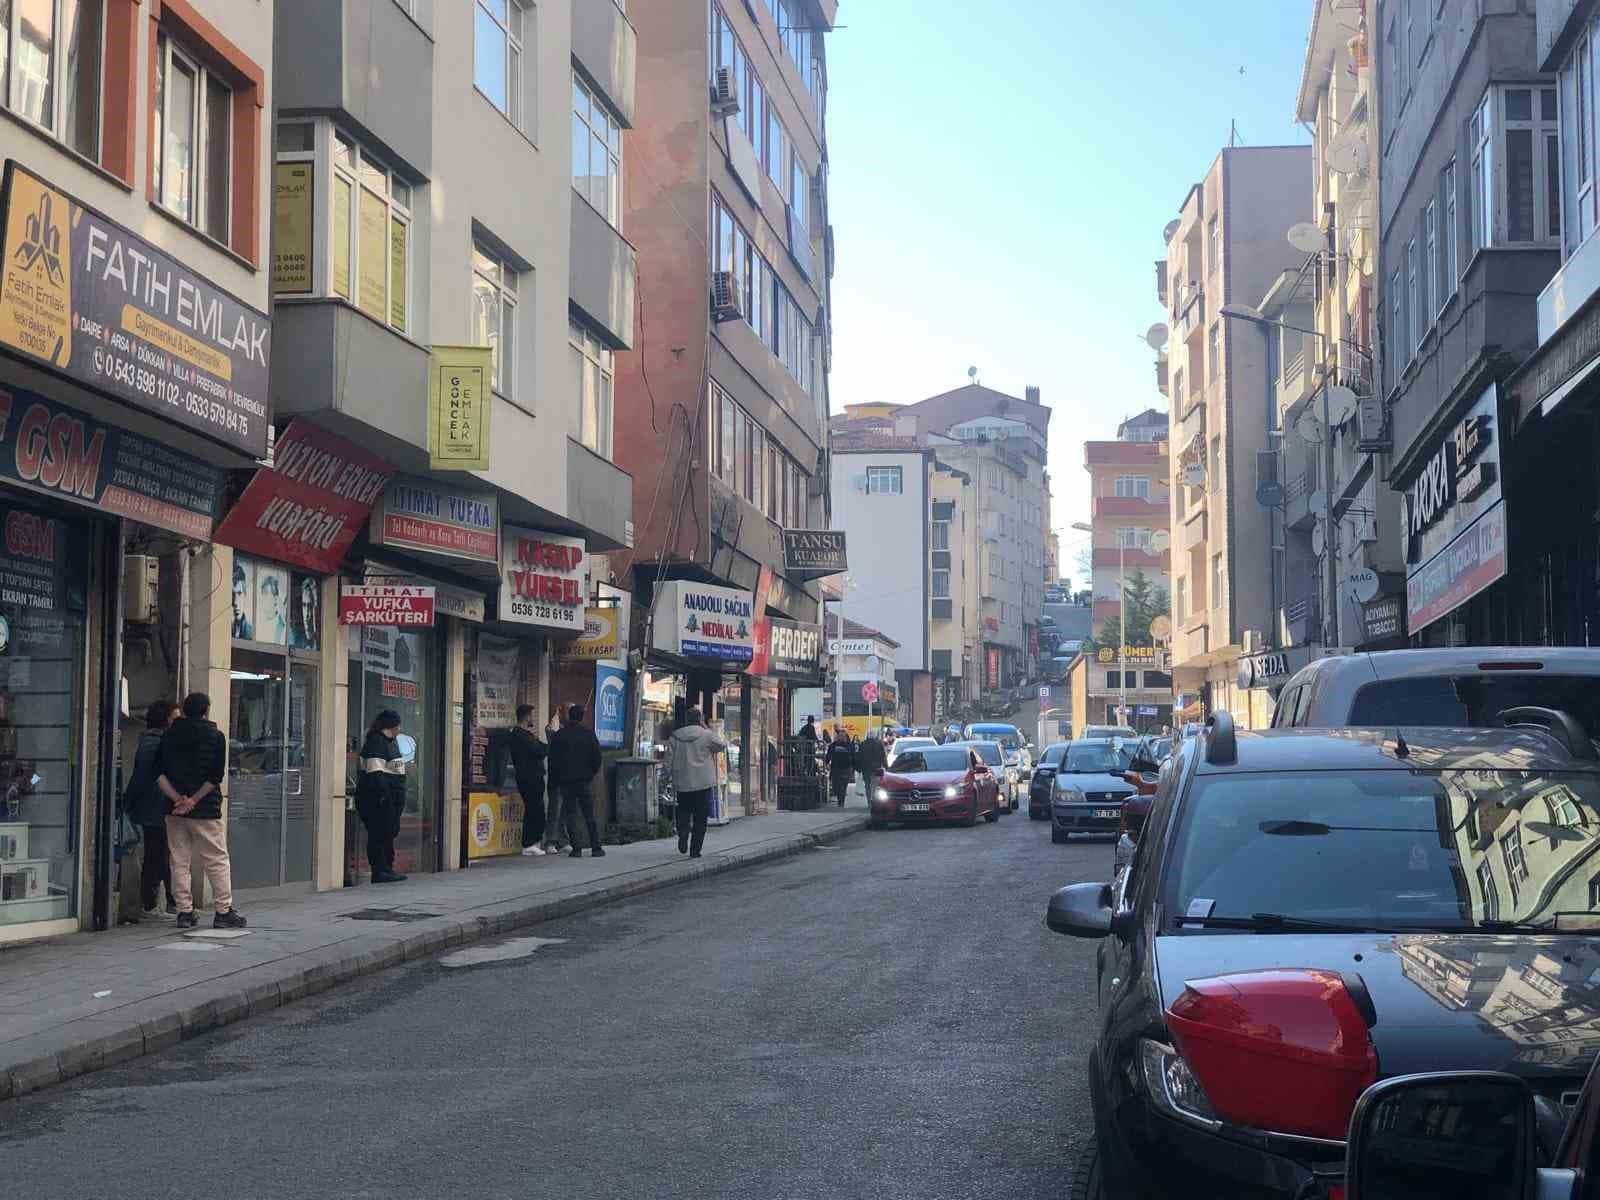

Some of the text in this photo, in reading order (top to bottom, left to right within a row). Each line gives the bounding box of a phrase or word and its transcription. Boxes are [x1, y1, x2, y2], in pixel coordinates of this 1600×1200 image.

[177, 278, 267, 368] EMLAK
[110, 332, 131, 353] ARSA
[185, 391, 209, 418] 0533
[16, 403, 106, 500] GSM
[448, 496, 491, 528] YUFKA
[6, 510, 54, 561] GSM
[514, 538, 583, 570] KASAP
[1350, 574, 1372, 583] MAG
[362, 597, 412, 610] YUFKA
[511, 603, 532, 616] 0536
[684, 593, 722, 613] ANADOLU
[345, 609, 428, 624] ŞARKÜTERİ
[588, 646, 615, 656] KASAP
[1255, 653, 1287, 677] SEDA
